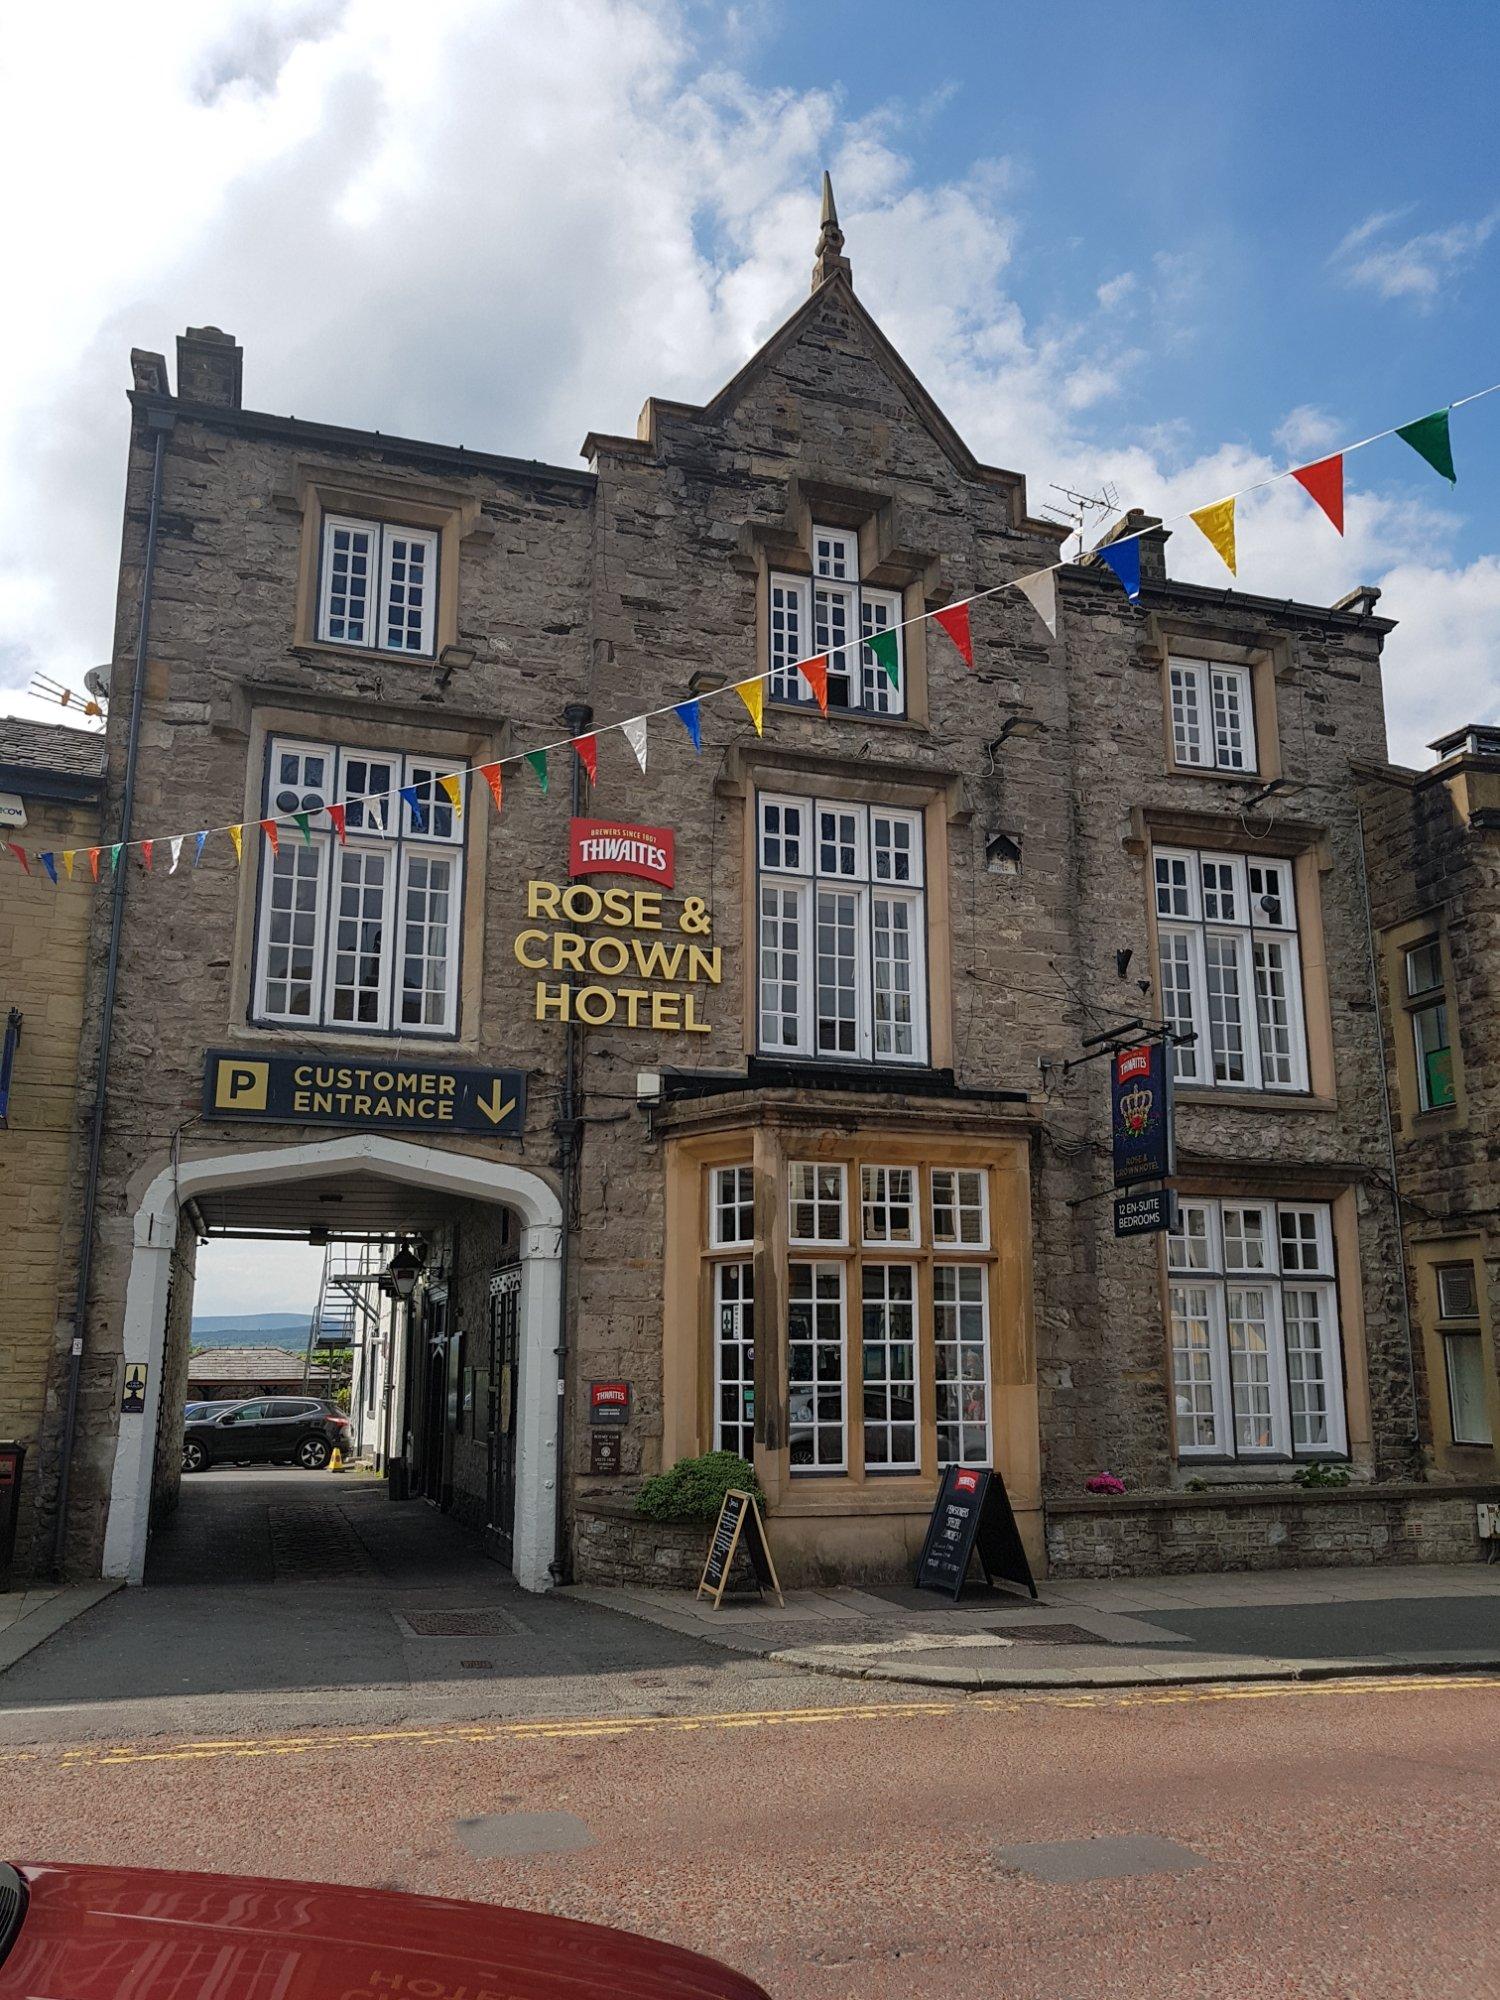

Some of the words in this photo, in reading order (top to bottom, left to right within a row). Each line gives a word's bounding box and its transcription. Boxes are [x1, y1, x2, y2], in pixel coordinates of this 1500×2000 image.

[590, 828, 621, 837] BREWERS
[622, 829, 641, 839] SINCE
[579, 838, 667, 871] THWAITES
[528, 881, 663, 930] ROSE
[679, 896, 711, 935] &
[514, 929, 722, 984] CROWN
[536, 982, 712, 1033] HOTEL
[229, 1070, 257, 1100] P
[294, 1066, 456, 1095] CUSTOMER
[294, 1091, 455, 1120] ENTRANCE
[1118, 1212, 1161, 1228] BEDROOMS
[1119, 1203, 1126, 1215] 12
[1126, 1198, 1160, 1213] EN-SUITE
